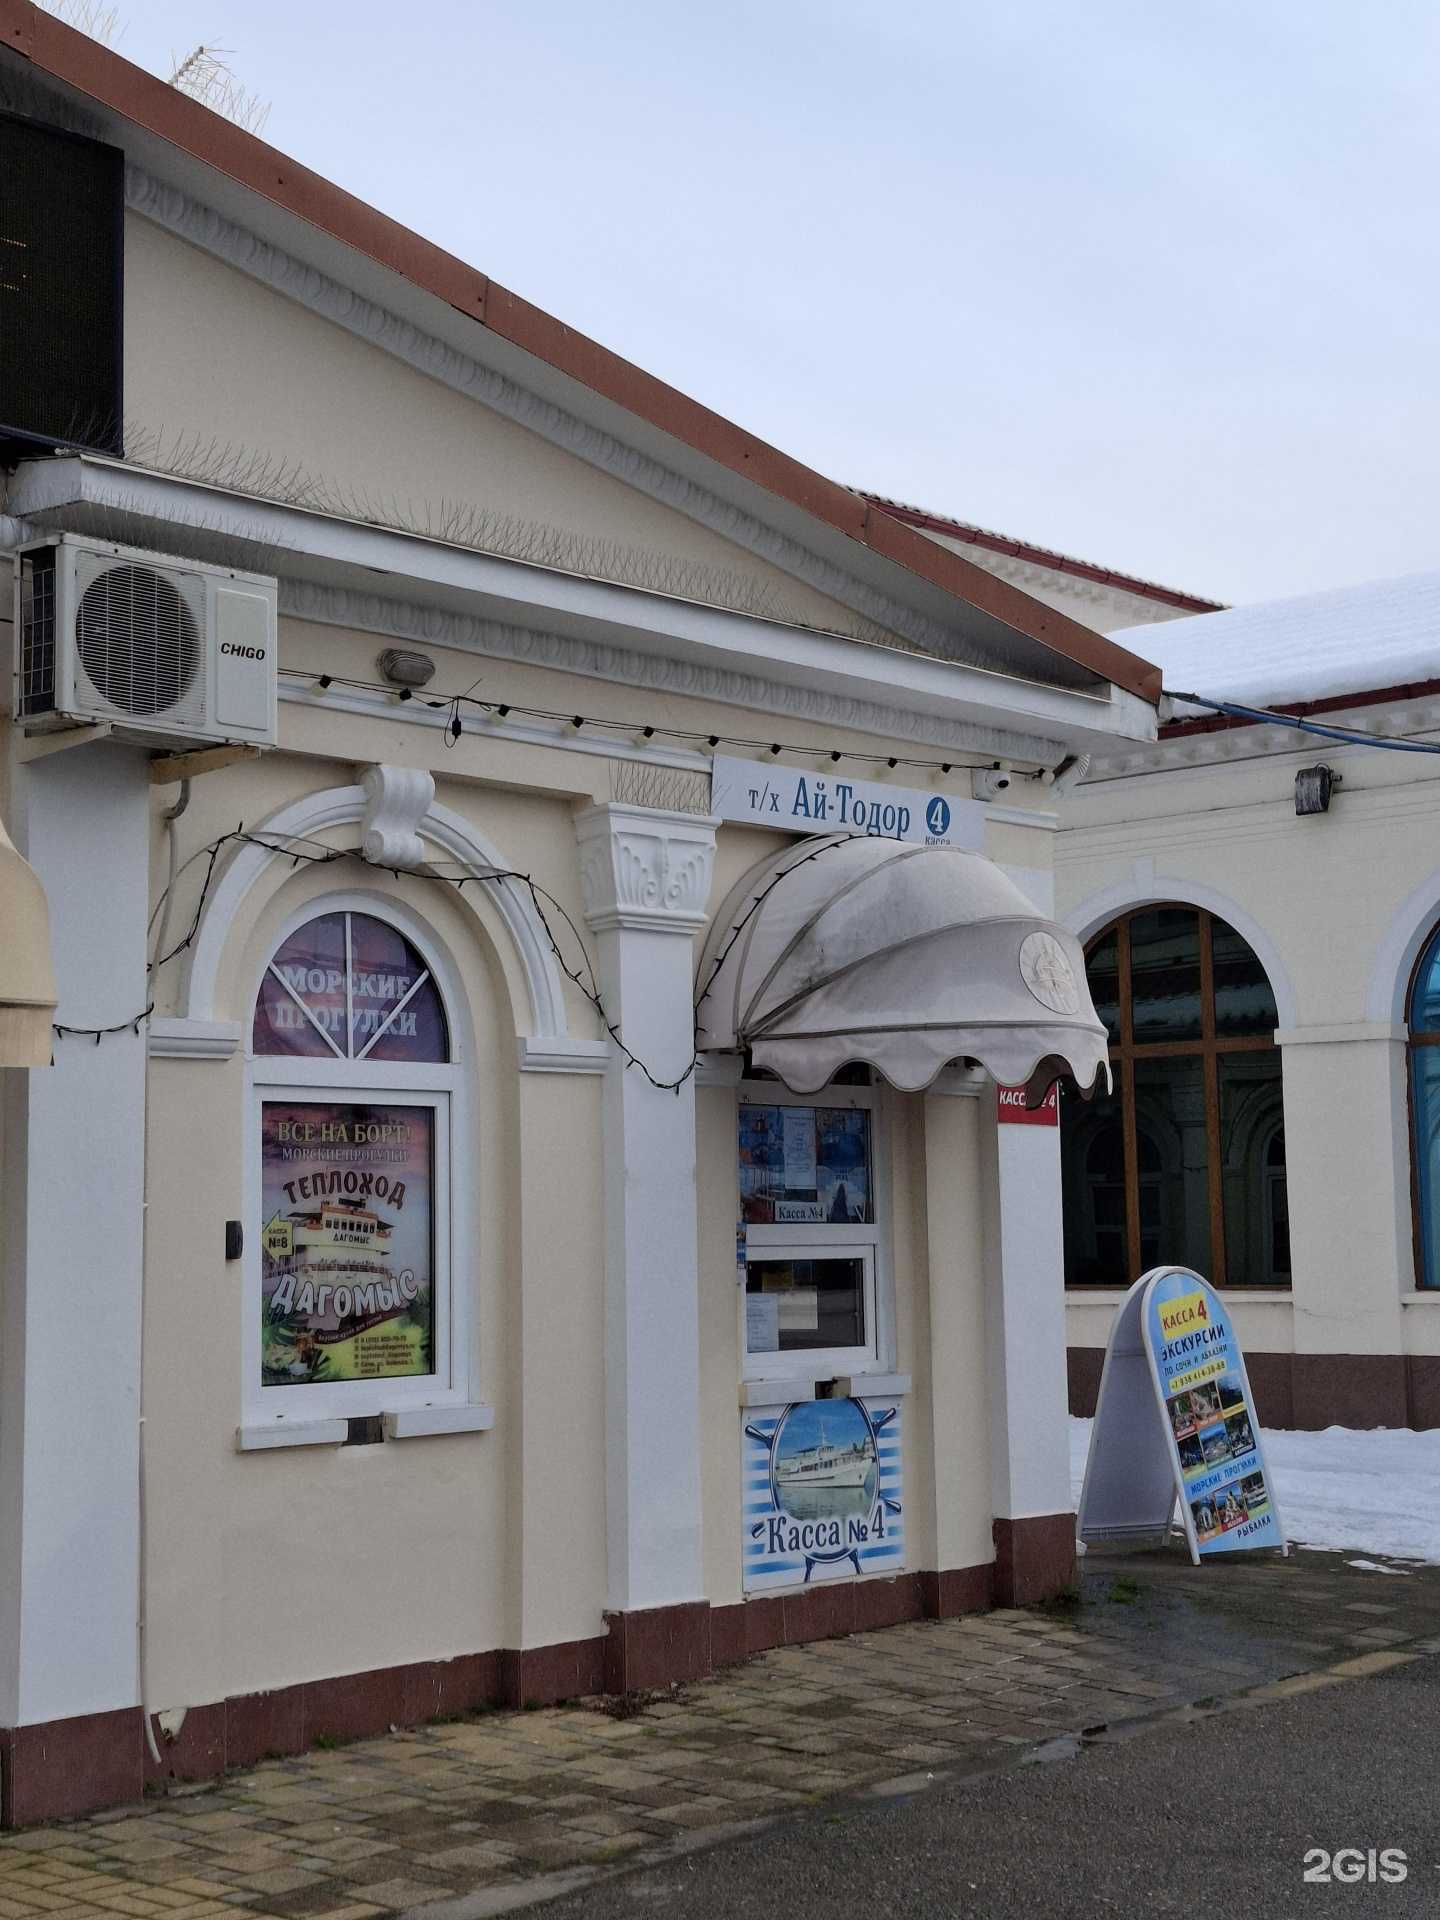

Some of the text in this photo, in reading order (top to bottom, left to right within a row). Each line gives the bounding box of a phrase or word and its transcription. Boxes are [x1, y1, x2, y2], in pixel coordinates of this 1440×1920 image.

[221, 642, 265, 660] CHIGO
[748, 777, 910, 840] т/х Ай-Тодор
[930, 801, 945, 832] 4
[1000, 1090, 1026, 1106] КАСС
[278, 1122, 412, 1144] ВСЕ НА БОРТ!
[282, 1170, 406, 1210] ТЕПЛОХОД
[778, 1206, 806, 1219] Касса
[268, 1237, 288, 1249] №8
[333, 1232, 371, 1244] ДАГОМЫС
[271, 1269, 418, 1318] ДАГОМЫС
[1162, 1300, 1207, 1330] КАССА 4
[1162, 1323, 1225, 1361] ЭКСКУРСИИ
[1191, 1473, 1222, 1495] МОРСКИЕ
[767, 1515, 840, 1554] Касса
[1237, 1515, 1271, 1538] РЫБАЛКА
